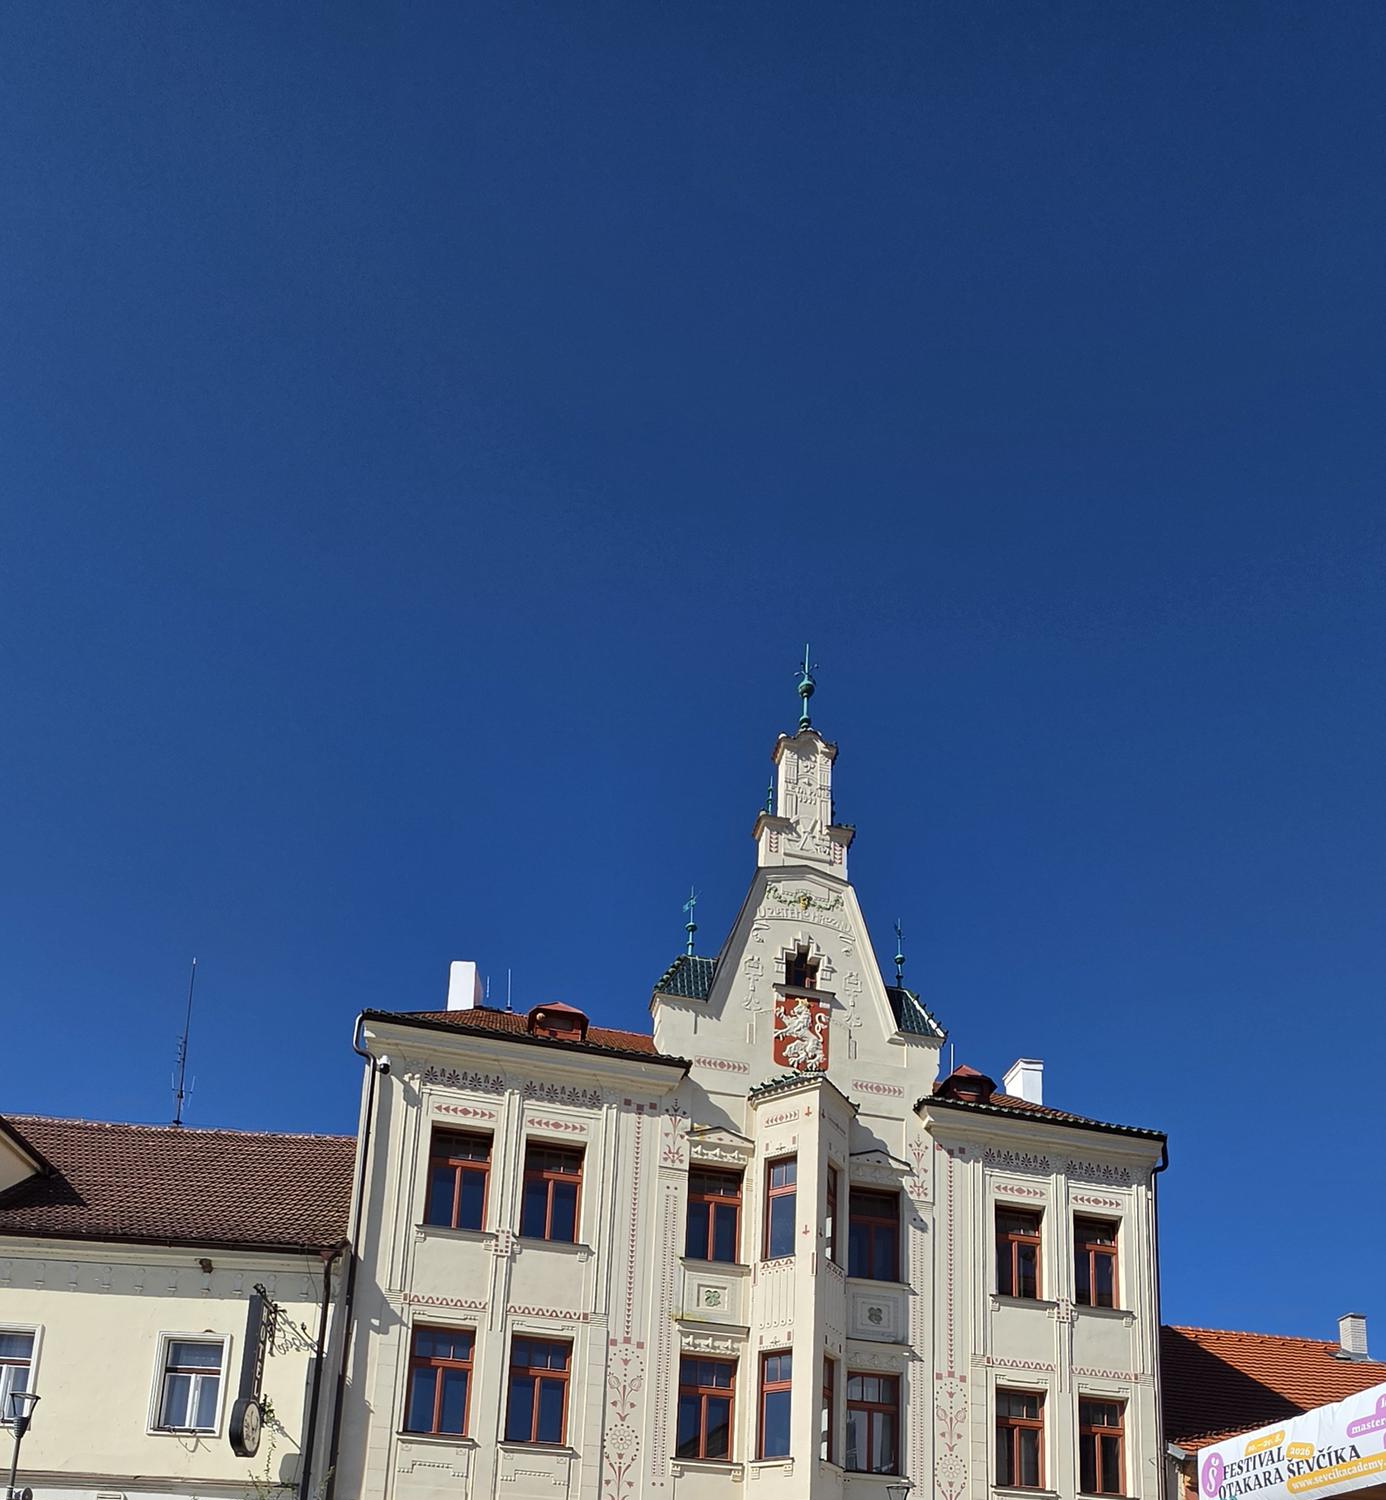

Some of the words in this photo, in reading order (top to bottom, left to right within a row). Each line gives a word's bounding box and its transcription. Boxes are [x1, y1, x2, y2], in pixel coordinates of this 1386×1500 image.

[253, 1305, 268, 1398] HOTEL
[1218, 1467, 1285, 1500] OTAKARA
[1286, 1444, 1361, 1479] ŠEVČÍKA
[1223, 1446, 1285, 1481] FESTIVAL
[1289, 1447, 1311, 1456] 2026
